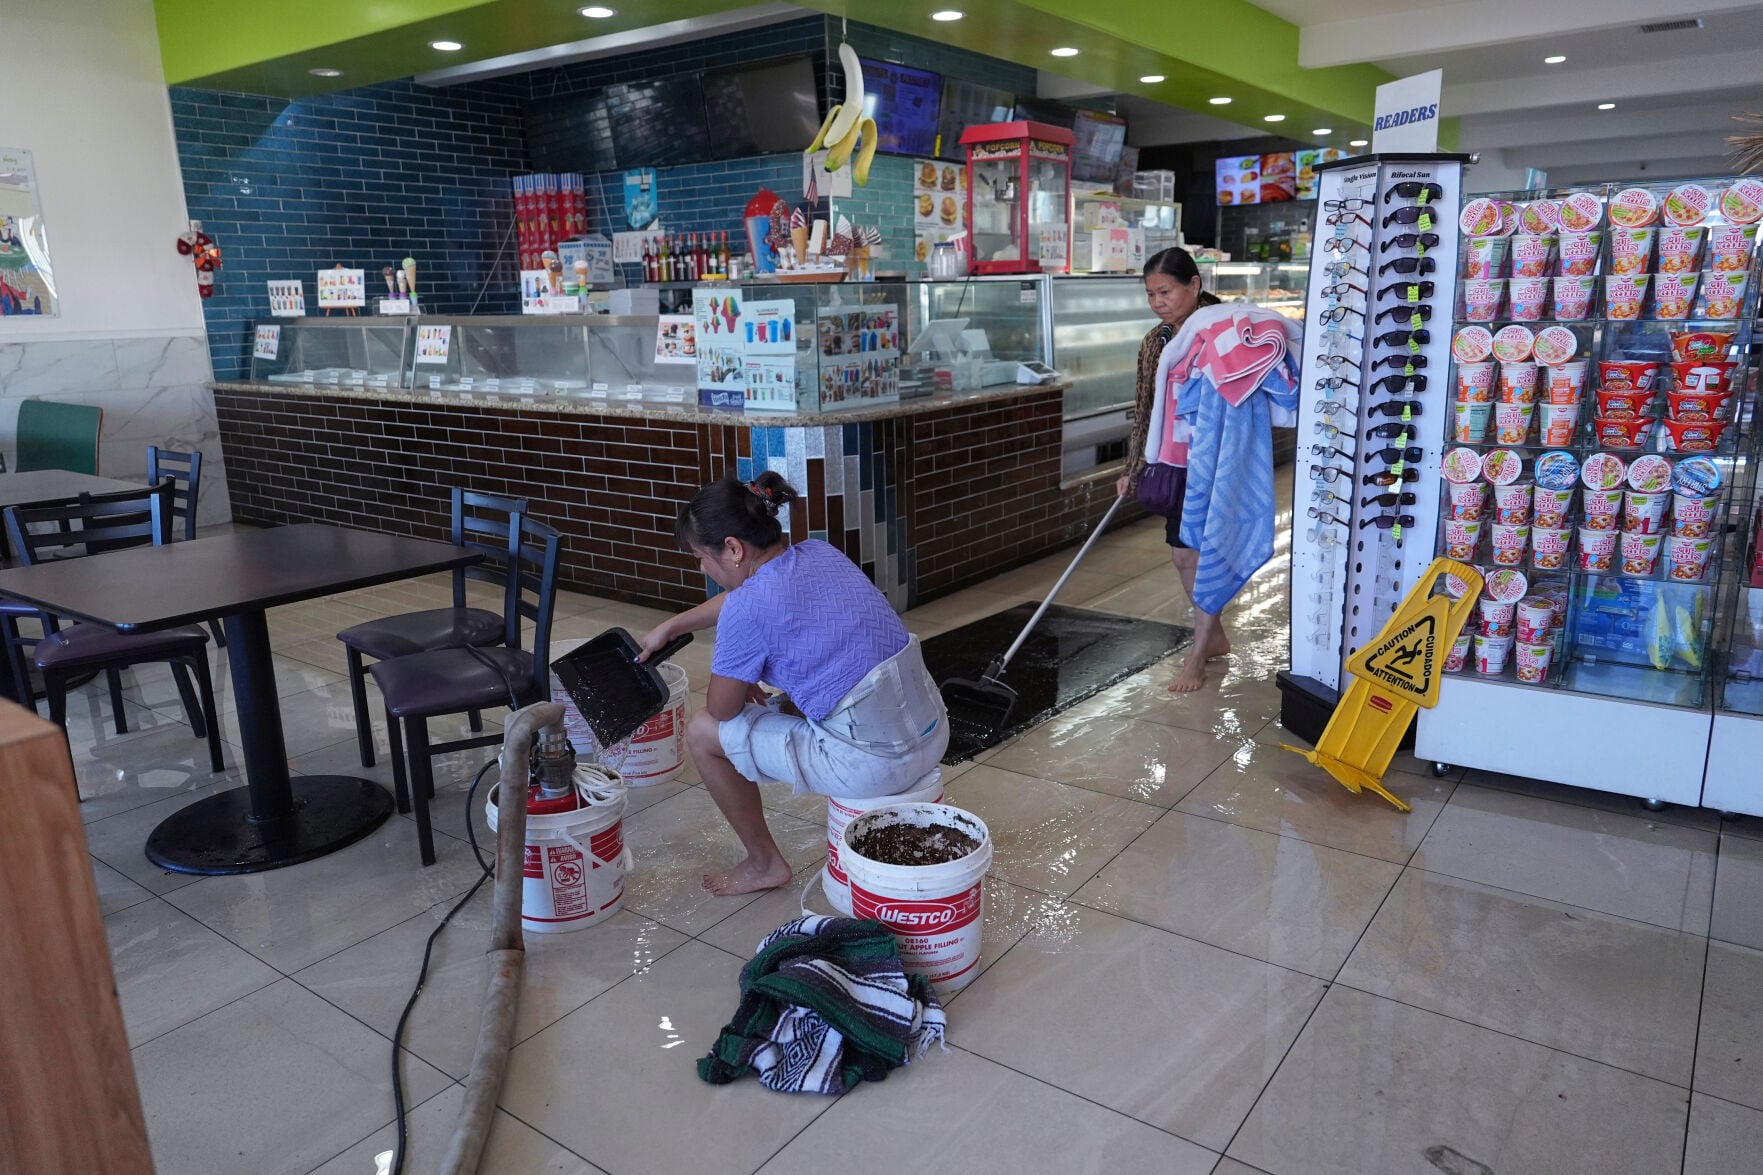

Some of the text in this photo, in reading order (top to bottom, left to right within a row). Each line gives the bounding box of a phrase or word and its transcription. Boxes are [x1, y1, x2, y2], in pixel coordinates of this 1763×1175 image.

[1374, 104, 1438, 132] READERS
[986, 141, 1021, 152] POPCORN
[1391, 171, 1417, 179] Bifocal
[1630, 191, 1648, 199] CUP
[1620, 195, 1651, 207] NOODLES
[1667, 235, 1687, 244] CUP
[1723, 234, 1744, 243] CUP
[1523, 242, 1541, 251] CUP
[1571, 241, 1592, 250] CUP
[1661, 242, 1692, 251] NOODLES
[1716, 240, 1750, 250] NOODLES
[1517, 249, 1546, 258] NOODLES
[1565, 247, 1595, 257] NOODLES
[1562, 284, 1581, 293] CUP
[1616, 283, 1635, 292] CUP
[1662, 282, 1682, 291] CUP
[1708, 281, 1728, 289] CUP
[1557, 290, 1587, 299] NOODLES
[1610, 289, 1641, 299] NOODLES
[1657, 288, 1688, 297] NOODLES
[1705, 287, 1736, 296] NOODLES
[1590, 498, 1608, 506] CUP
[1585, 503, 1614, 512] NOODLES
[1685, 504, 1704, 513] CUP
[1679, 510, 1710, 519] NOODLES
[1677, 546, 1696, 555] CUP
[1671, 552, 1702, 560] NOODLES
[1377, 624, 1416, 657] CAUTION
[1424, 635, 1435, 677] CUIDADO
[1373, 667, 1416, 692] ATTENTION
[880, 906, 952, 925] WESTCO
[909, 942, 932, 951] APPLE
[934, 938, 959, 950] FILLING
